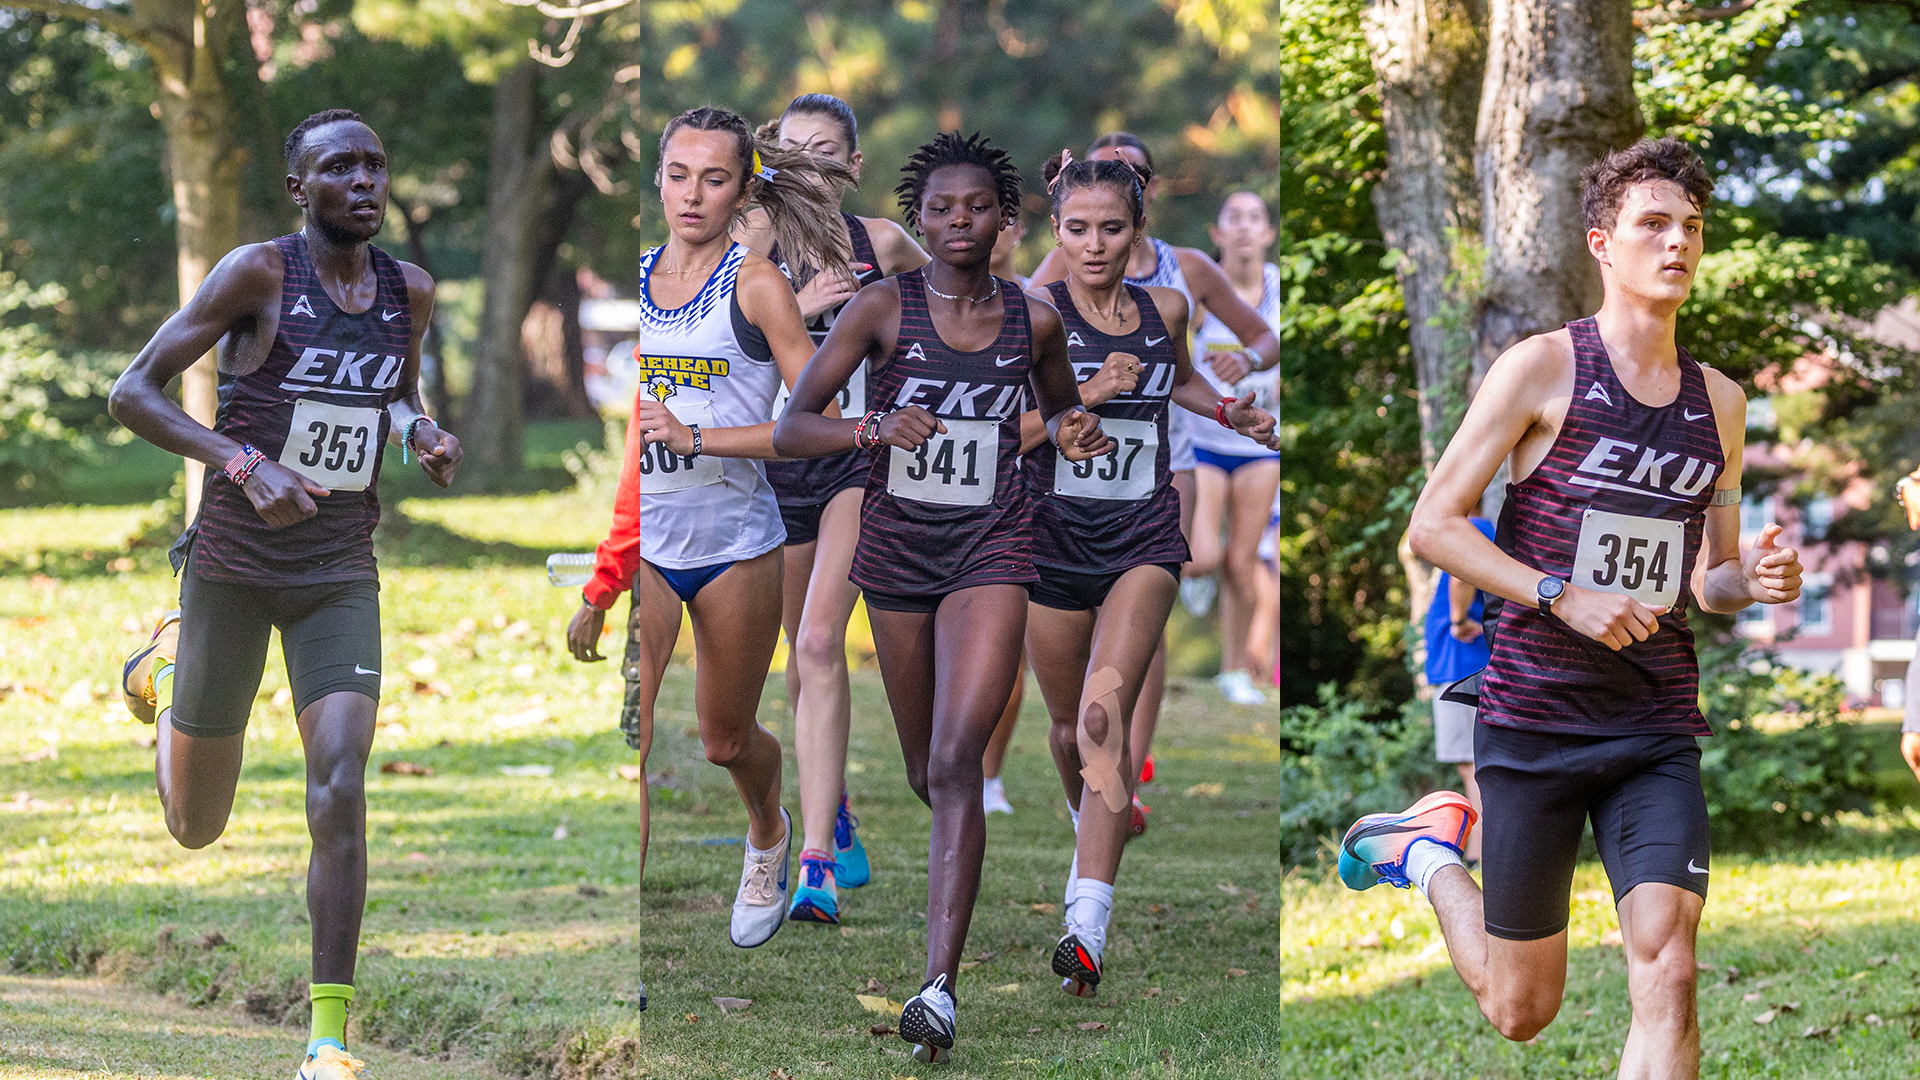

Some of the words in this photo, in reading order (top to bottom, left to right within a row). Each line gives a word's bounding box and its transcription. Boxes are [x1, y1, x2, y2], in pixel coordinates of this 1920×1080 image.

[286, 347, 405, 389] EKU
[1070, 362, 1176, 397] EU
[894, 377, 1024, 418] EKU
[299, 421, 369, 473] 353
[906, 439, 980, 486] 341
[1577, 437, 1717, 496] EKU
[1592, 533, 1669, 593] 354
